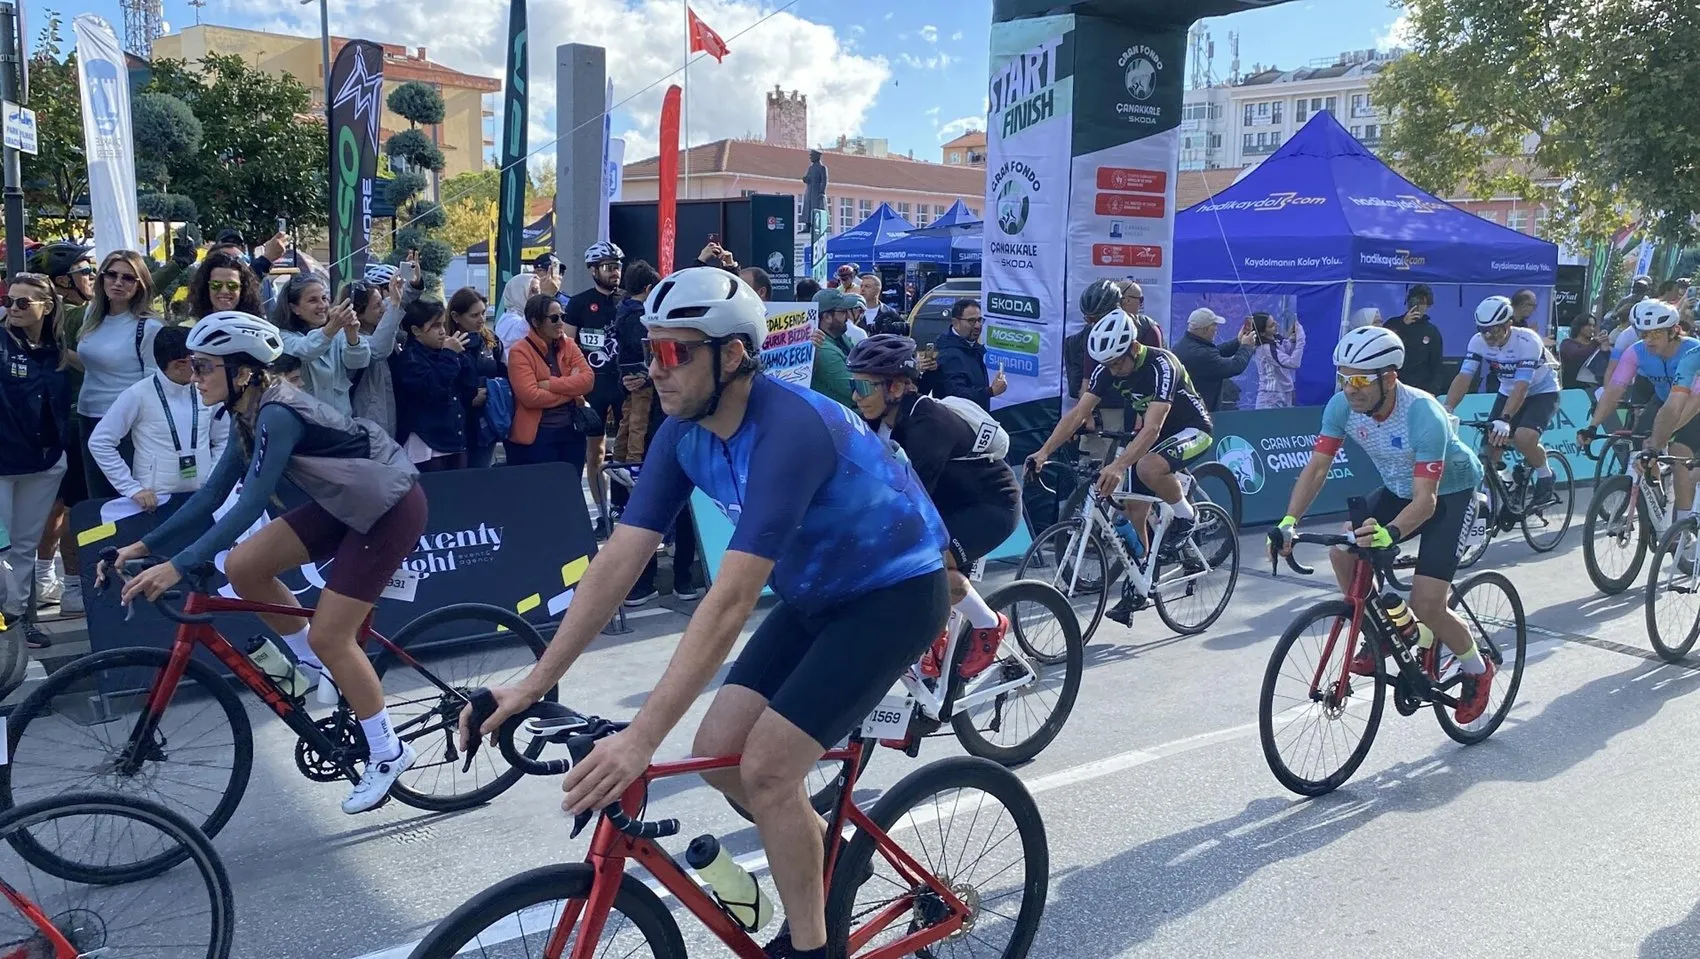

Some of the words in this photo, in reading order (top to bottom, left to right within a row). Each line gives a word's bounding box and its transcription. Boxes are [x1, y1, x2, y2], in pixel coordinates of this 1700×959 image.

[1117, 45, 1139, 67] GRAN
[1140, 45, 1164, 70] FONDO
[988, 36, 1063, 118] START
[1002, 88, 1054, 140] FINISH
[1116, 103, 1161, 116] ÇANAKKALE
[1128, 115, 1157, 124] SKODA
[991, 161, 1010, 192] GRAN
[1010, 161, 1041, 191] FONDO
[879, 251, 907, 259] SHIMANO
[990, 242, 1037, 256] ÇANAKKALE
[1001, 258, 1034, 269] SKODA
[1296, 257, 1320, 268] Kolay
[991, 297, 1034, 314] SKODA
[783, 312, 807, 331] SENDE
[584, 335, 599, 345] 123
[761, 332, 787, 350] GURUR
[991, 329, 1033, 344] MOSSO
[788, 342, 813, 368] EREN
[988, 354, 1033, 371] SHIMANO
[977, 428, 992, 449] 1551
[1260, 437, 1290, 451] GRAN
[1291, 434, 1321, 448] FOND
[401, 550, 456, 580] ight
[872, 710, 901, 724] 1569
